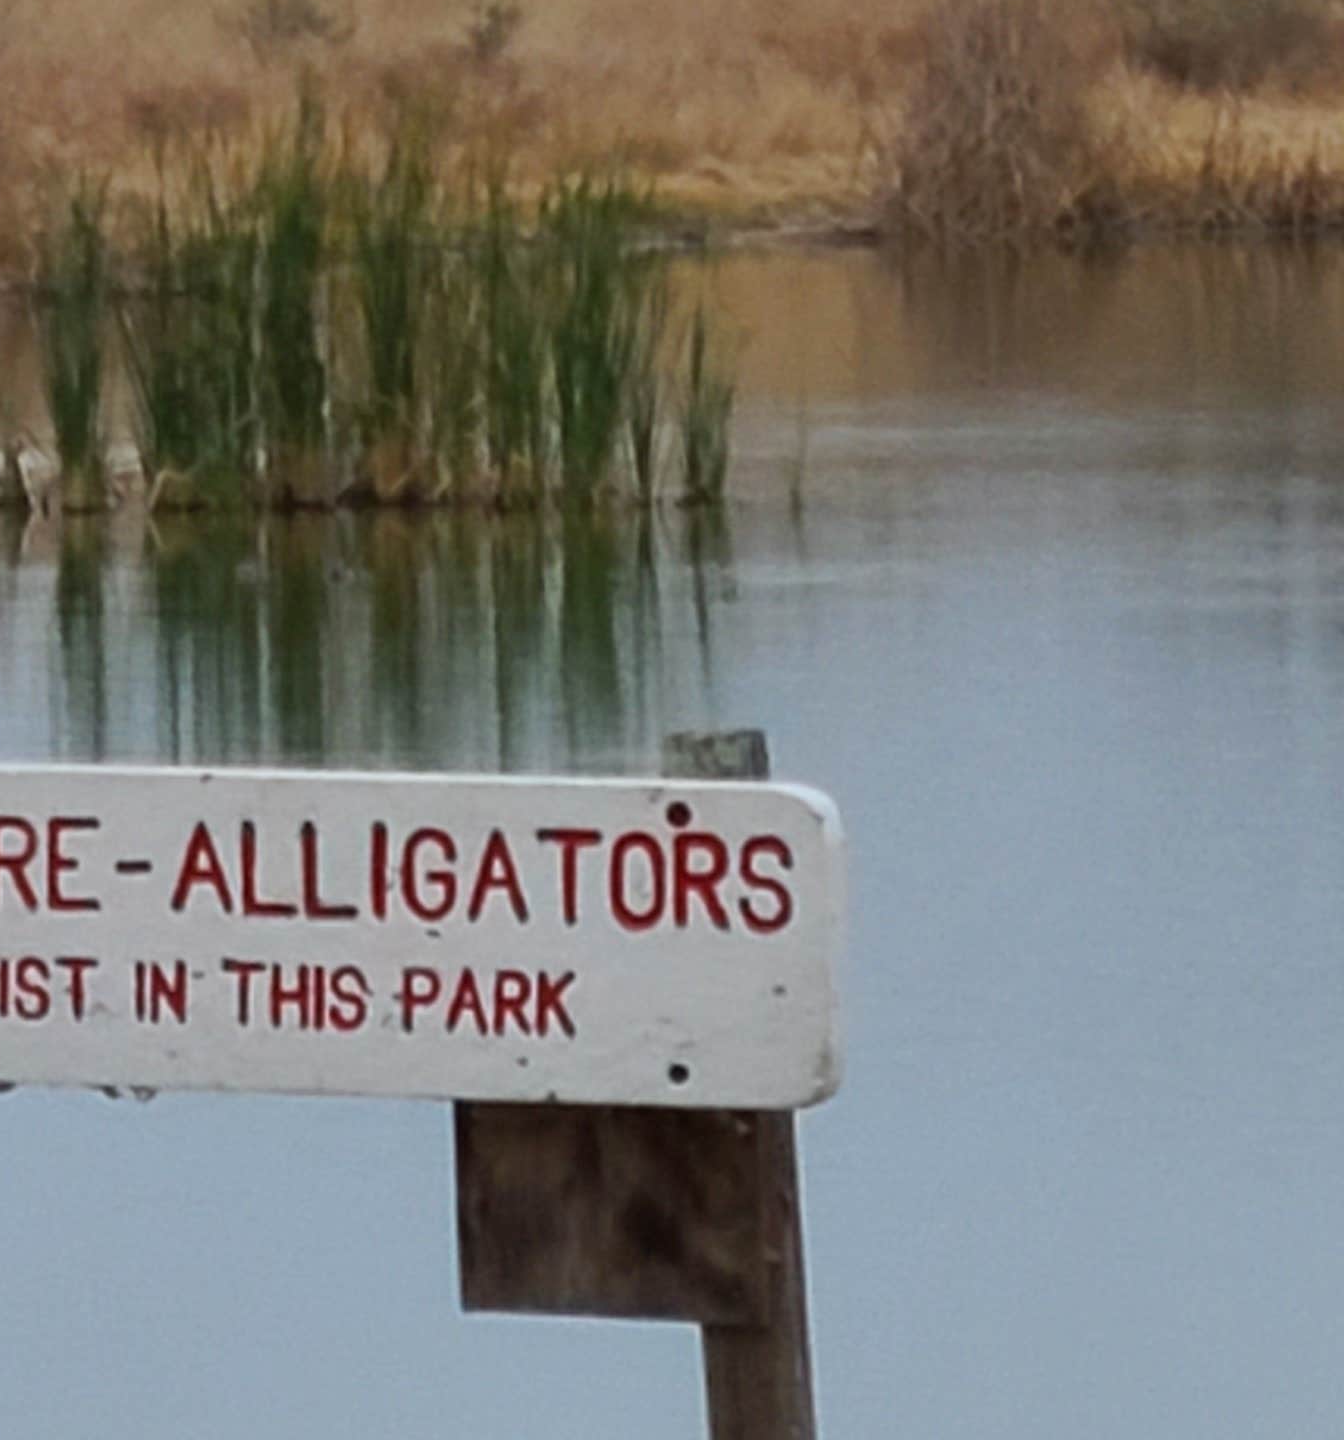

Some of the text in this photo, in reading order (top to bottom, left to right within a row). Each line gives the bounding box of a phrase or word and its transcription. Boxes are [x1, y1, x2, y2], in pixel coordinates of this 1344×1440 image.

[134, 961, 189, 1025] IN
[221, 957, 368, 1032] THIS
[400, 968, 577, 1038] PARK
